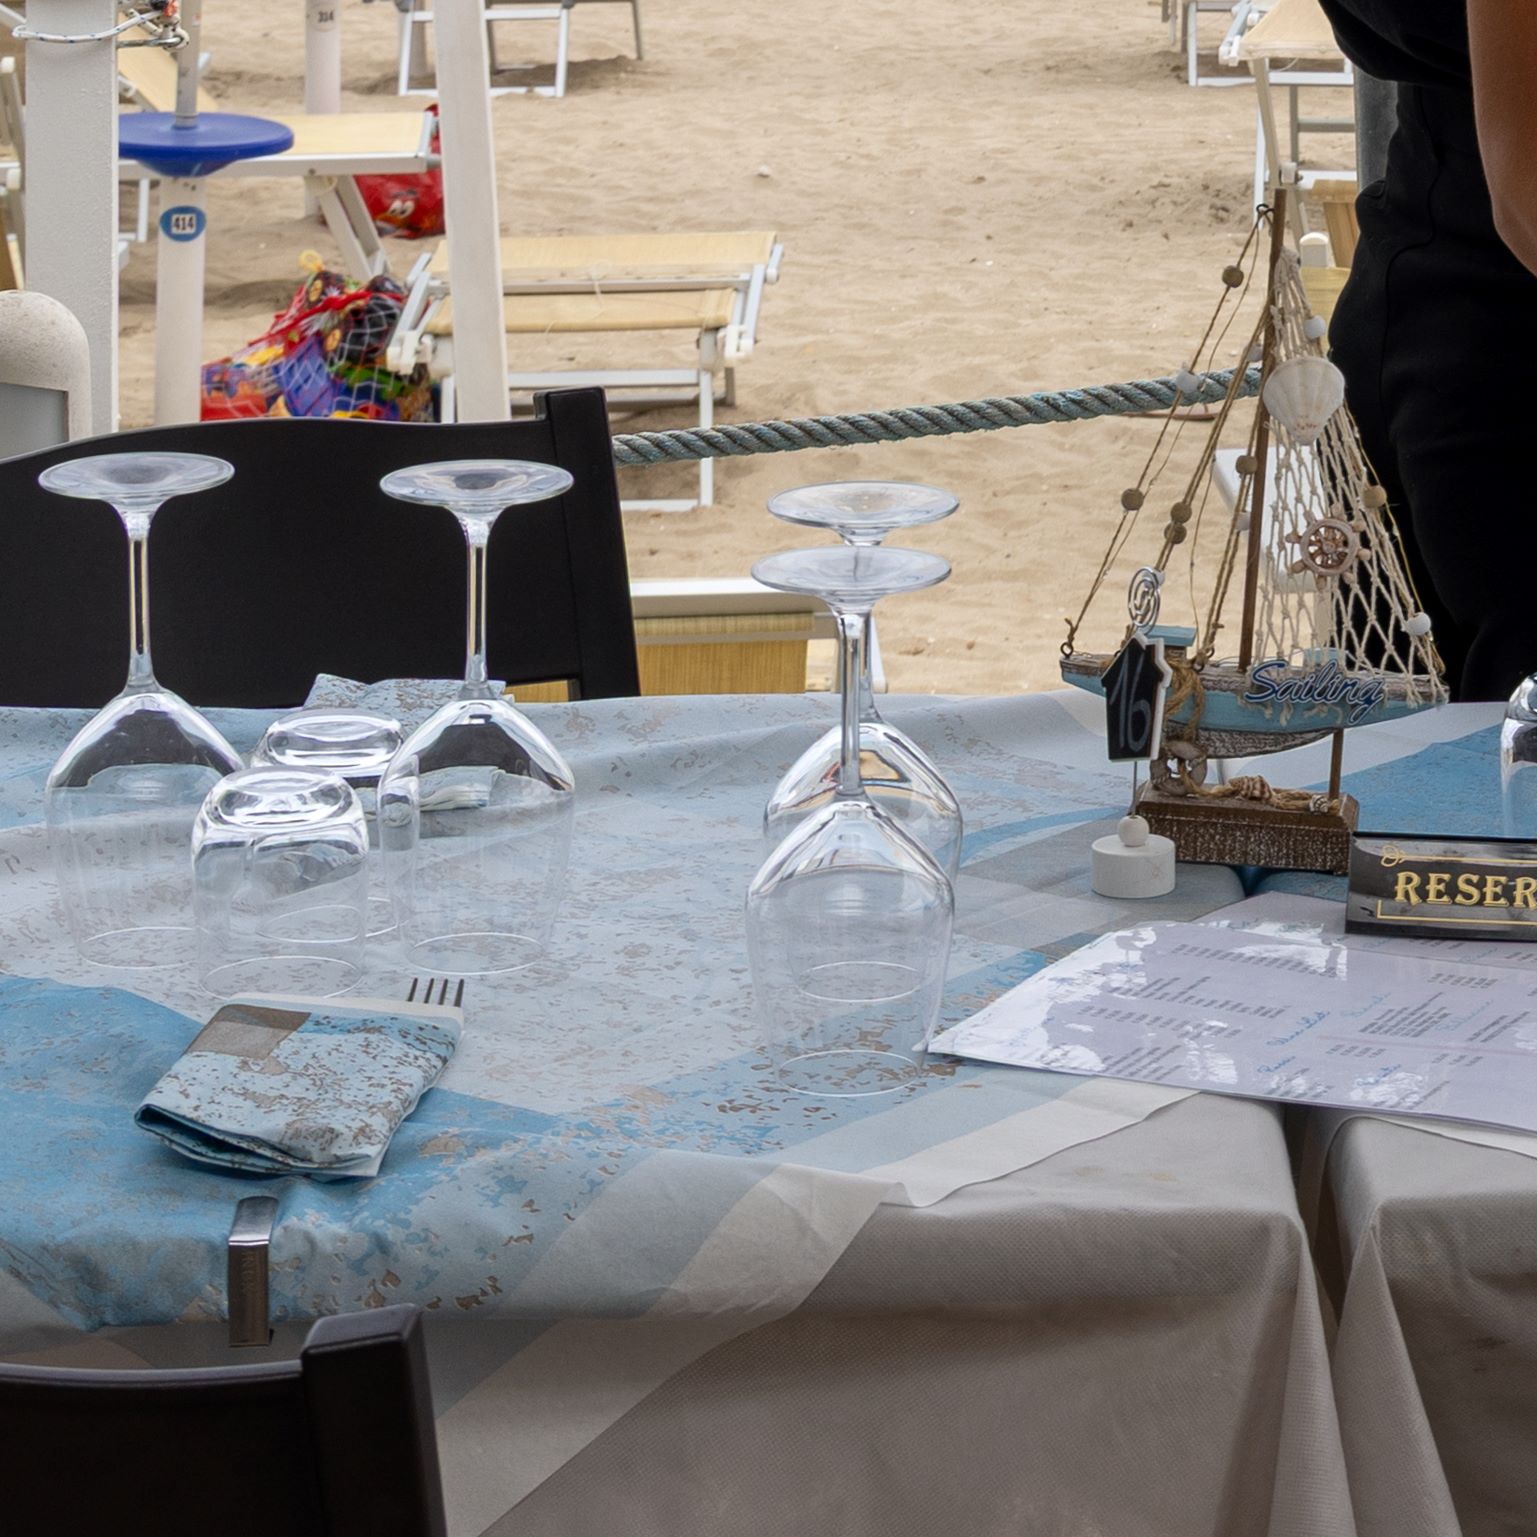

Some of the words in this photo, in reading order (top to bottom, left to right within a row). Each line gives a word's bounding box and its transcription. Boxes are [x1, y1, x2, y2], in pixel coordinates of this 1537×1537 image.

[174, 215, 194, 231] 414
[1109, 650, 1151, 752] 16
[1244, 659, 1386, 726] Sailing
